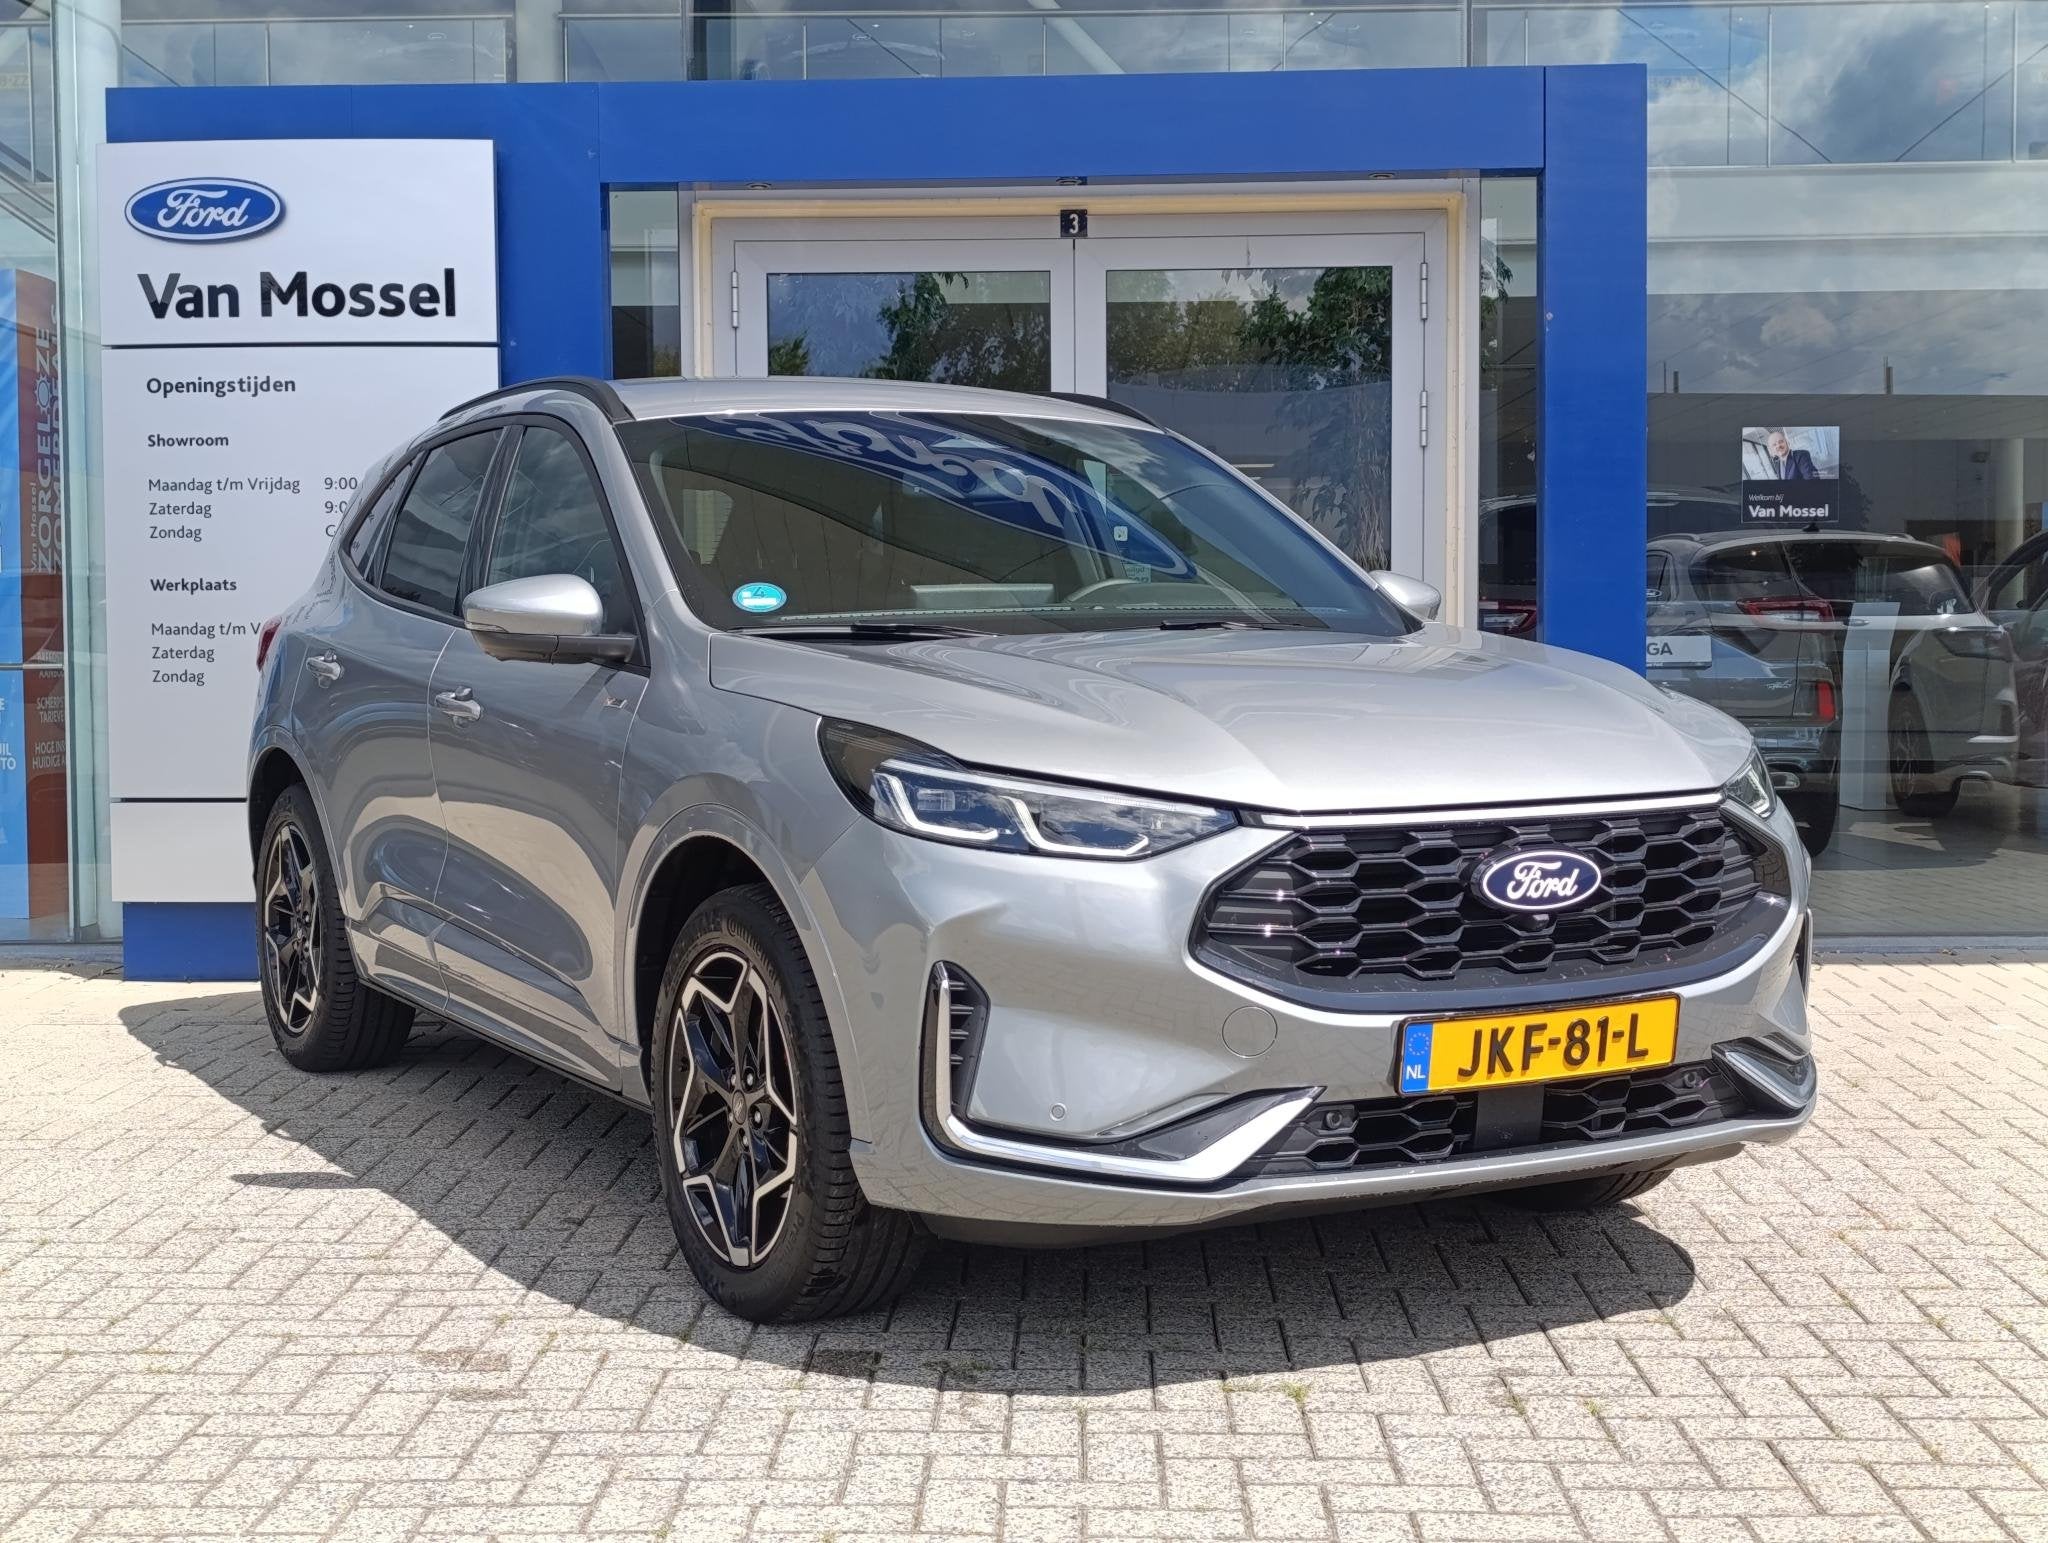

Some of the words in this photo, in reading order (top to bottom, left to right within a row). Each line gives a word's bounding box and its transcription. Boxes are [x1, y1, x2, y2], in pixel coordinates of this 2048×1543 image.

[156, 188, 251, 229] Ford
[1070, 213, 1079, 234] 3
[137, 273, 240, 319] Van
[260, 268, 456, 318] Mossel
[146, 376, 295, 398] Openingstijden
[148, 434, 229, 447] Showroom
[149, 477, 212, 494] Maandag
[216, 477, 243, 491] t/m
[248, 477, 300, 494] Vrijdag
[324, 477, 358, 490] 9:00
[1748, 494, 1774, 502] Welkom
[30, 481, 38, 537] Mossel
[149, 501, 212, 518] Zaterdag
[324, 500, 348, 514] 9:0
[1749, 505, 1776, 518] Van
[1779, 503, 1830, 518] Mossel
[150, 525, 202, 542] Zondag
[150, 578, 237, 595] Werkplaats
[152, 622, 215, 639] Maandag
[219, 622, 246, 635] t/m
[152, 645, 214, 662] Zaterdag
[1646, 642, 1674, 656] GA
[152, 669, 205, 686] Zondag
[40, 711, 64, 723] TARIEVE
[1506, 860, 1580, 900] Ford
[1405, 1064, 1426, 1081] NL
[1457, 1012, 1649, 1079] JKF-81-L
